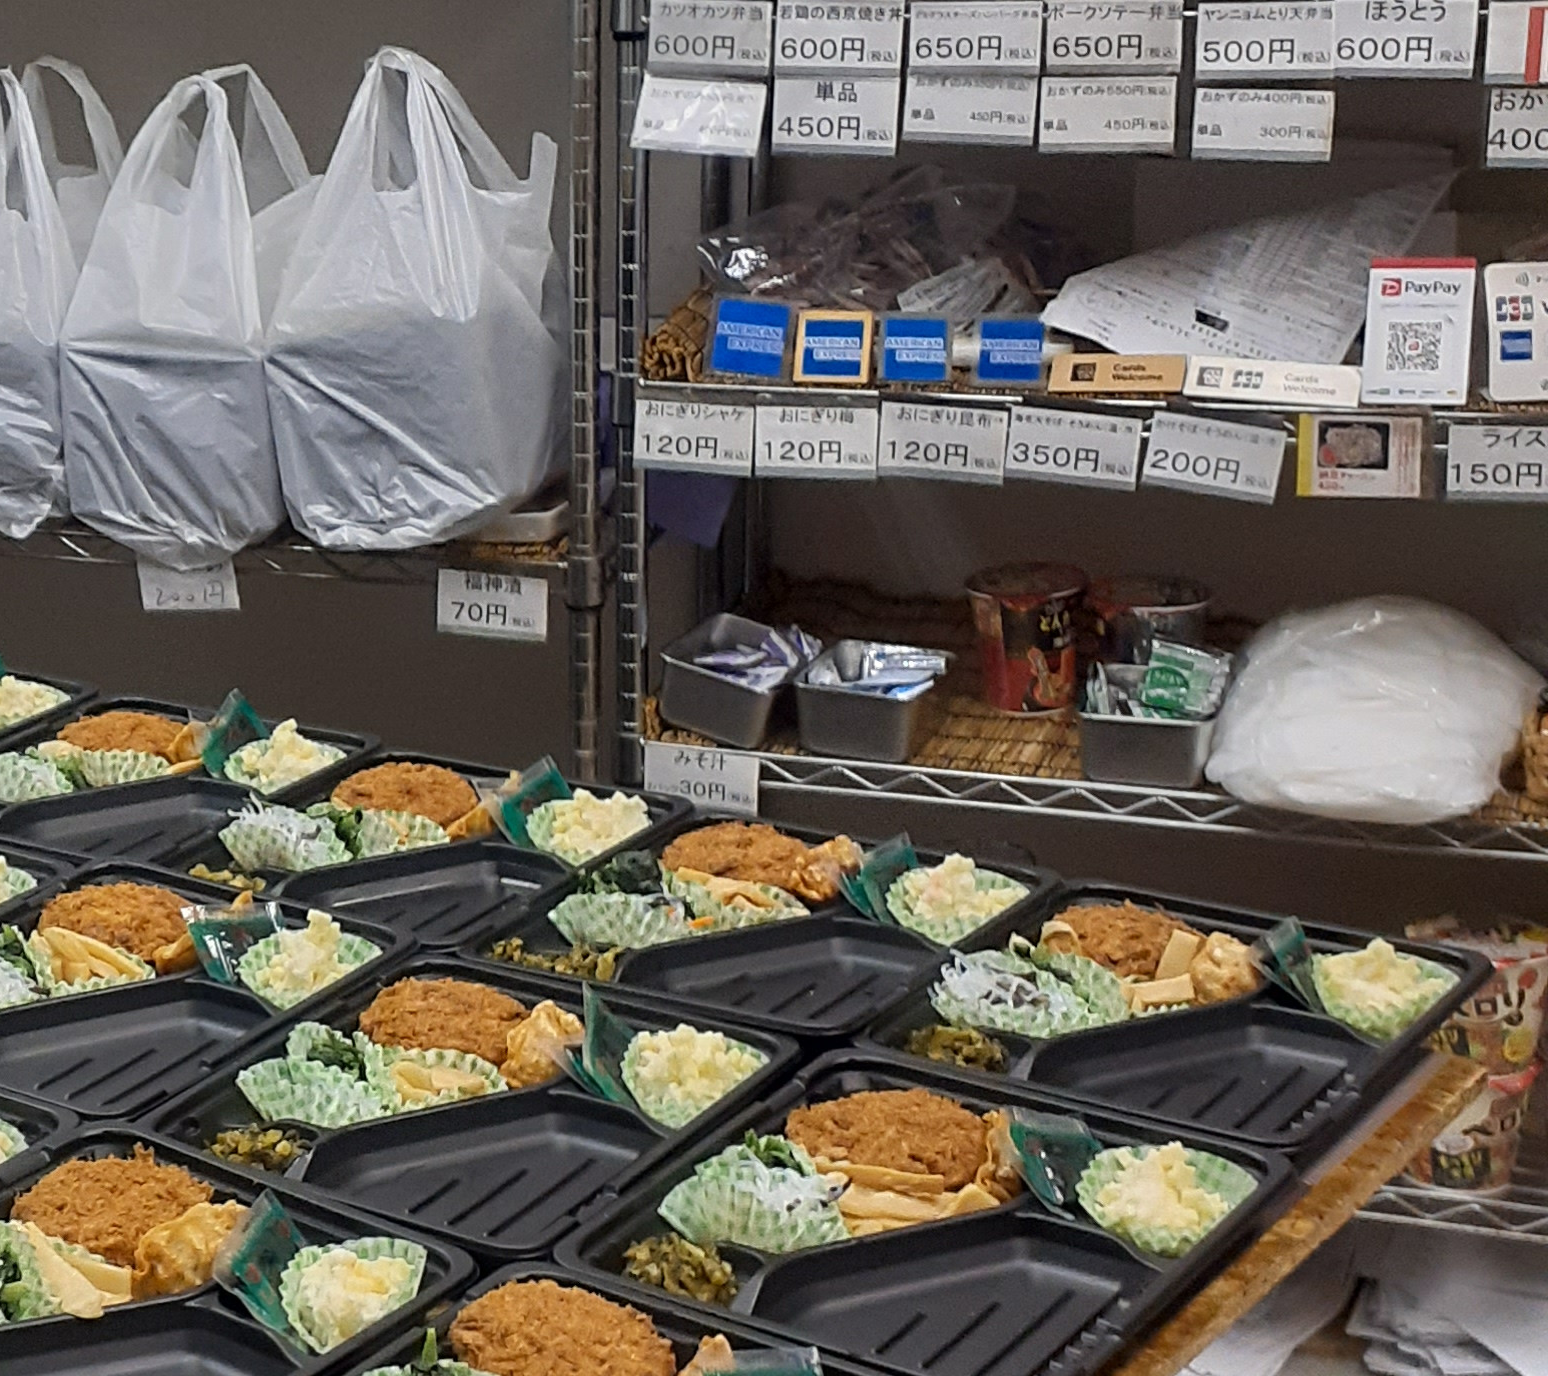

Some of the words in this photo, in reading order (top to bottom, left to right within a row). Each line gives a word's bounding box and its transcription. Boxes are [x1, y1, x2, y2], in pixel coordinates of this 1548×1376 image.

[660, 3, 764, 22] カツオカツ弁当
[814, 81, 859, 104] 単品
[1404, 280, 1462, 296] PayPay
[716, 320, 784, 340] AMERICAN
[804, 336, 861, 349] AMERICAN
[884, 337, 944, 349] AMERICAN
[980, 338, 1040, 351] AMERICAN
[1113, 363, 1147, 374] Cards
[1112, 371, 1163, 383] Welcome
[1284, 372, 1320, 385] Cards
[1282, 382, 1337, 397] Welcome
[1481, 427, 1547, 448] ライス
[673, 749, 727, 772] みそ汁
